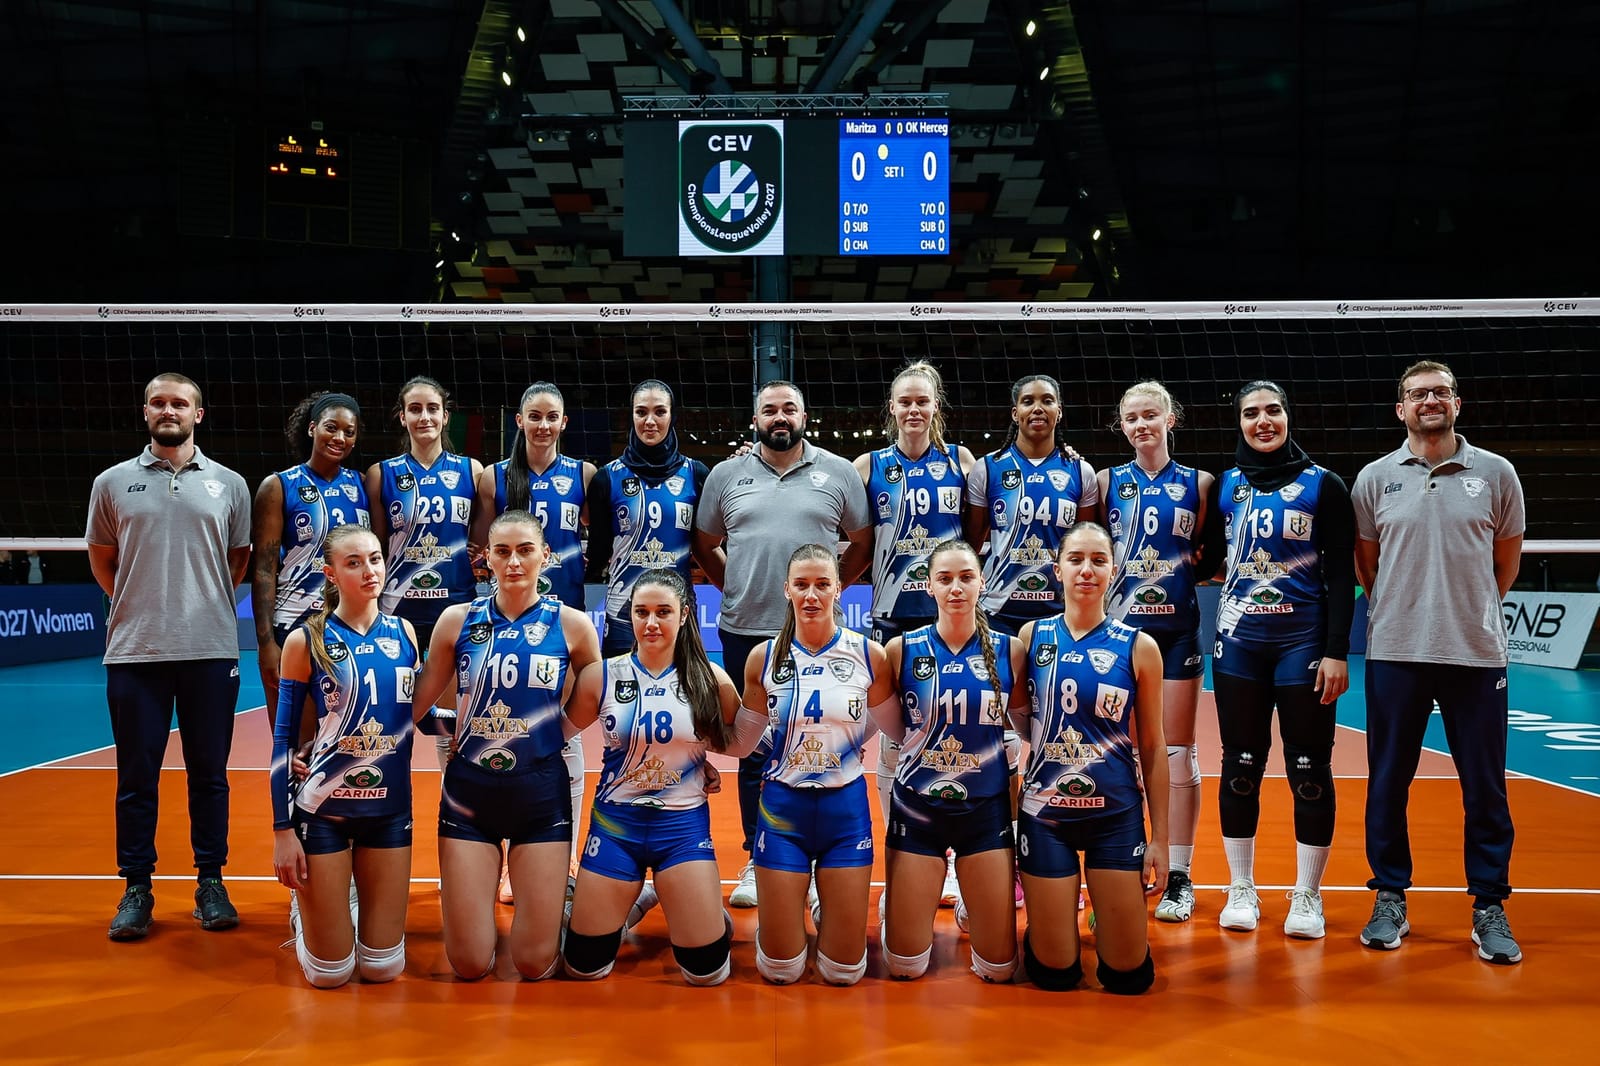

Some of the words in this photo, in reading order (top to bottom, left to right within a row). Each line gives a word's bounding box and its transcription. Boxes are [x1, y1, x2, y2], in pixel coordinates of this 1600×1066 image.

[846, 122, 877, 134] Maritza
[885, 122, 892, 134] 0
[897, 122, 903, 134] 0
[906, 122, 918, 133] OK
[920, 122, 948, 136] Herceg
[708, 134, 752, 152] CEV
[852, 152, 865, 181] 0
[884, 166, 899, 177] SET
[923, 151, 937, 181] 0
[765, 183, 775, 207] 2027
[844, 202, 850, 216] 0
[852, 203, 868, 216] T/O
[920, 203, 936, 216] T/O
[938, 201, 945, 215] 0
[844, 220, 850, 234] 0
[852, 221, 868, 232] SUB
[920, 221, 936, 232] SUB
[938, 219, 945, 233] 0
[844, 238, 850, 252] 0
[852, 240, 868, 250] CHA
[920, 240, 936, 250] CHA
[938, 237, 945, 251] 0
[3, 308, 22, 316] CEV
[306, 308, 325, 316] CEV
[906, 488, 930, 515] 19
[417, 496, 445, 523] 23
[648, 501, 662, 528] 9
[1020, 496, 1051, 526] 94
[332, 508, 345, 528] 3
[1144, 506, 1158, 535] 6
[1248, 508, 1274, 538] 13
[896, 538, 942, 550] SEVEN
[405, 546, 451, 558] SEVEN
[631, 551, 676, 562] SEVEN
[1010, 550, 1056, 560] SEVEN
[1126, 560, 1174, 572] SEVEN
[1238, 562, 1289, 574] SEVEN
[1246, 605, 1292, 613] CARINE
[0, 609, 27, 637] 027
[30, 608, 94, 634] Women
[1508, 640, 1551, 653] ESSIONAL
[487, 653, 519, 689] 16
[364, 668, 378, 705] 1
[1061, 678, 1078, 714] 8
[804, 689, 823, 723] 4
[939, 689, 967, 725] 11
[471, 719, 529, 733] SEVEN
[639, 710, 673, 744] 18
[338, 736, 399, 750] SEVEN
[921, 750, 982, 767] SEVEN
[1044, 744, 1103, 759] SEVEN
[787, 753, 841, 767] SEVEN
[356, 776, 369, 786] C
[625, 770, 683, 784] SEVEN
[332, 789, 386, 798] CARINE
[1069, 783, 1081, 794] C
[1050, 797, 1103, 806] CARINE
[585, 835, 600, 857] 18
[757, 831, 765, 852] 4
[1020, 833, 1029, 856] 8
